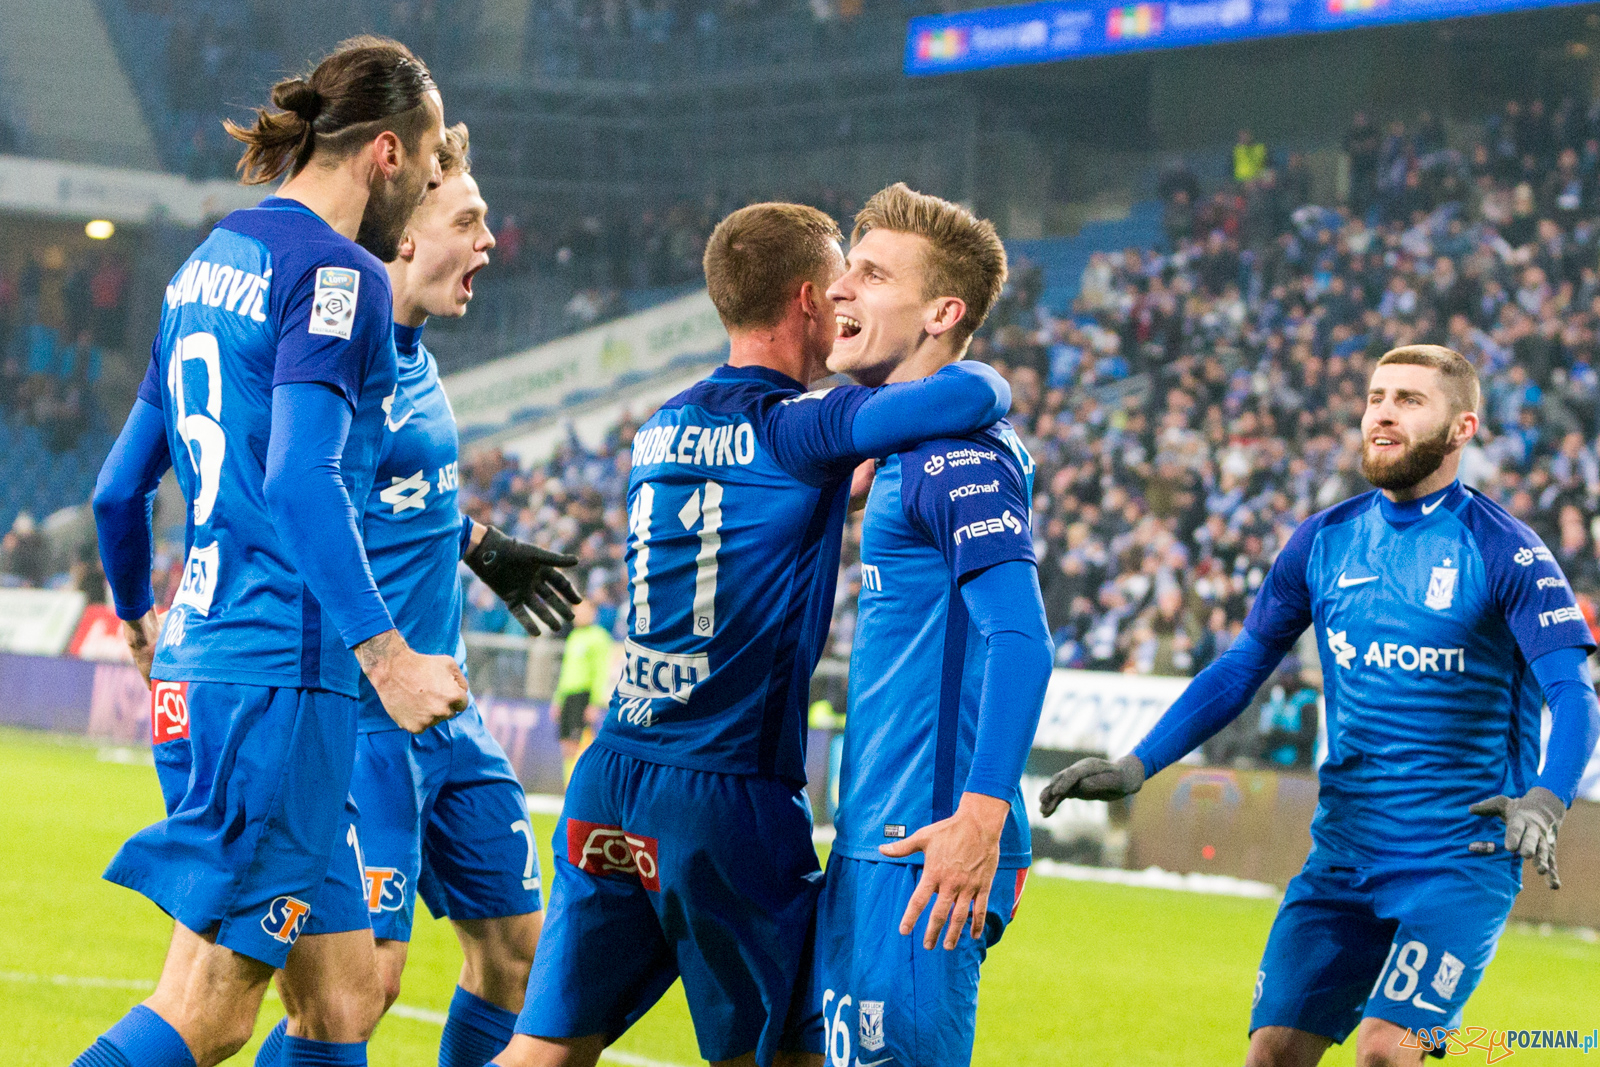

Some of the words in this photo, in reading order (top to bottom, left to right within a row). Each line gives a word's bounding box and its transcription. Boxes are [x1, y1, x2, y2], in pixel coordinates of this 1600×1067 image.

[946, 448, 997, 461] cashback
[948, 455, 981, 467] world
[629, 479, 724, 638] 11
[1364, 641, 1465, 672] AFORTI
[261, 896, 311, 944] STS
[1369, 940, 1429, 1002] 18
